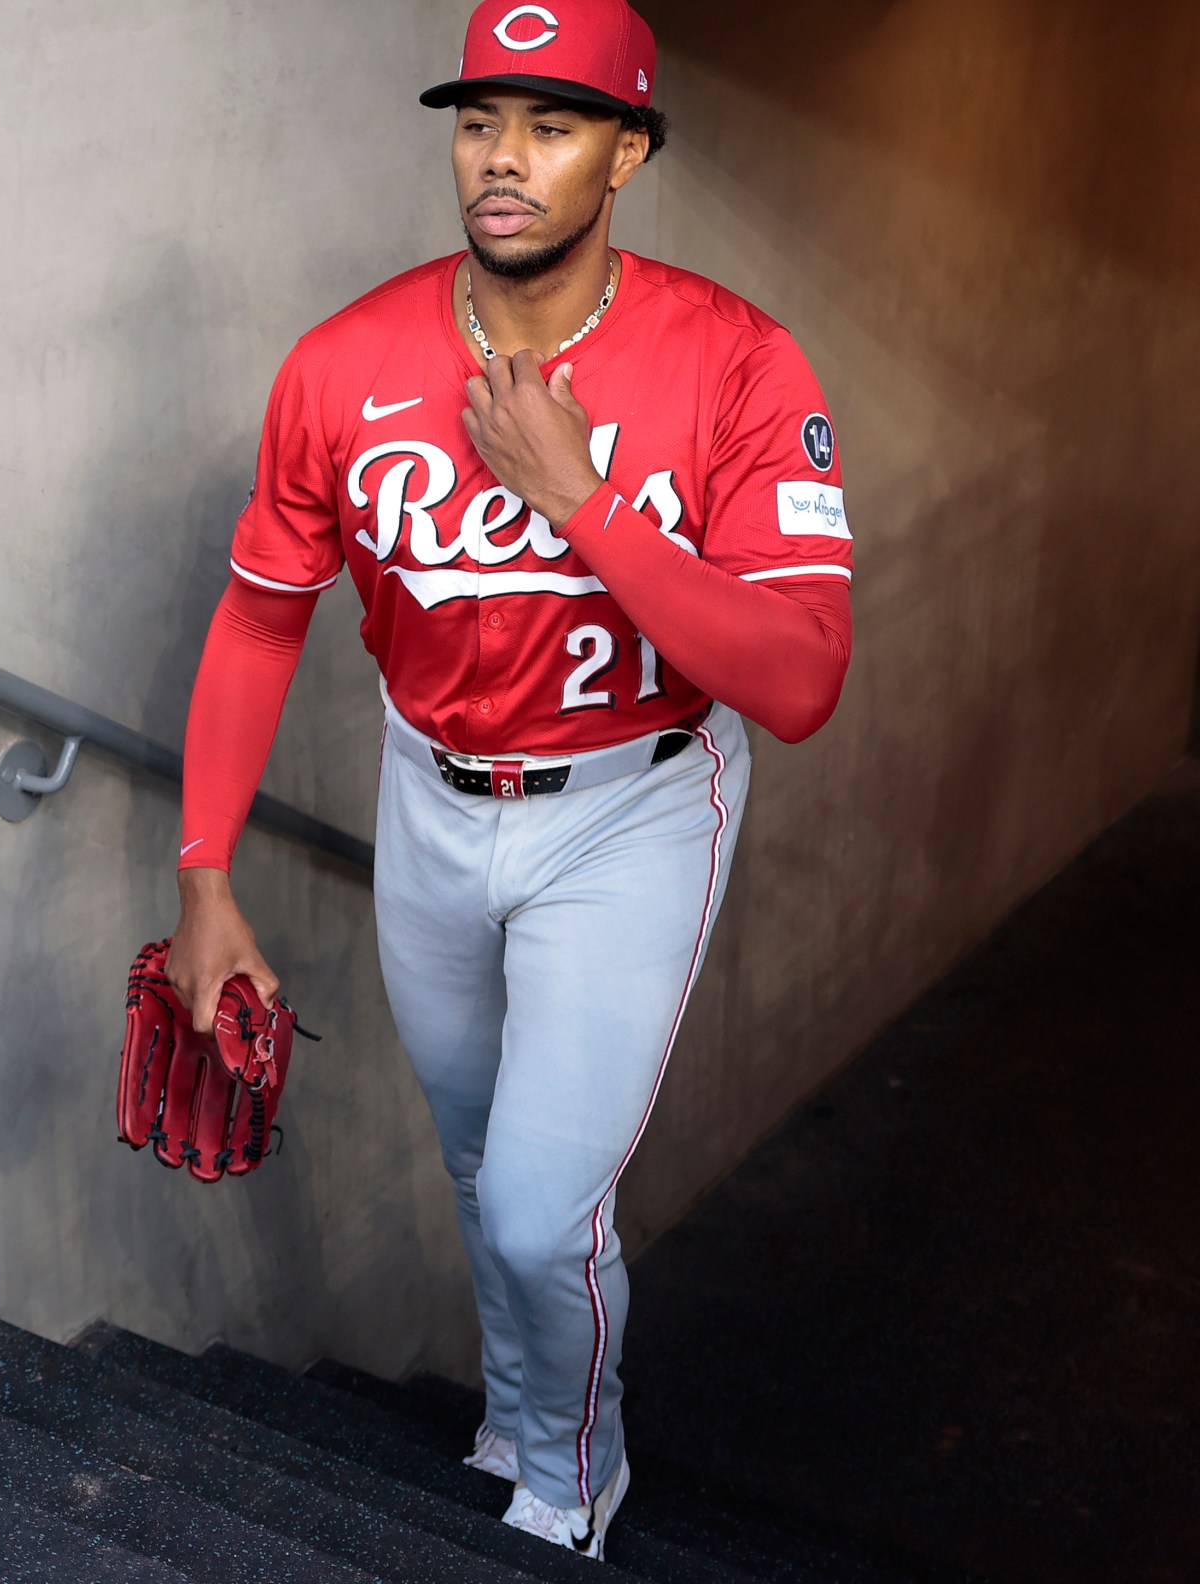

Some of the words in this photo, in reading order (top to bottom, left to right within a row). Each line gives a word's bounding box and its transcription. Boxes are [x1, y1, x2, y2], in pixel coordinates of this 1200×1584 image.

[492, 4, 559, 52] C
[808, 424, 831, 461] 14
[813, 493, 843, 527] Kroger
[556, 622, 667, 716] 21
[500, 779, 516, 797] 21
